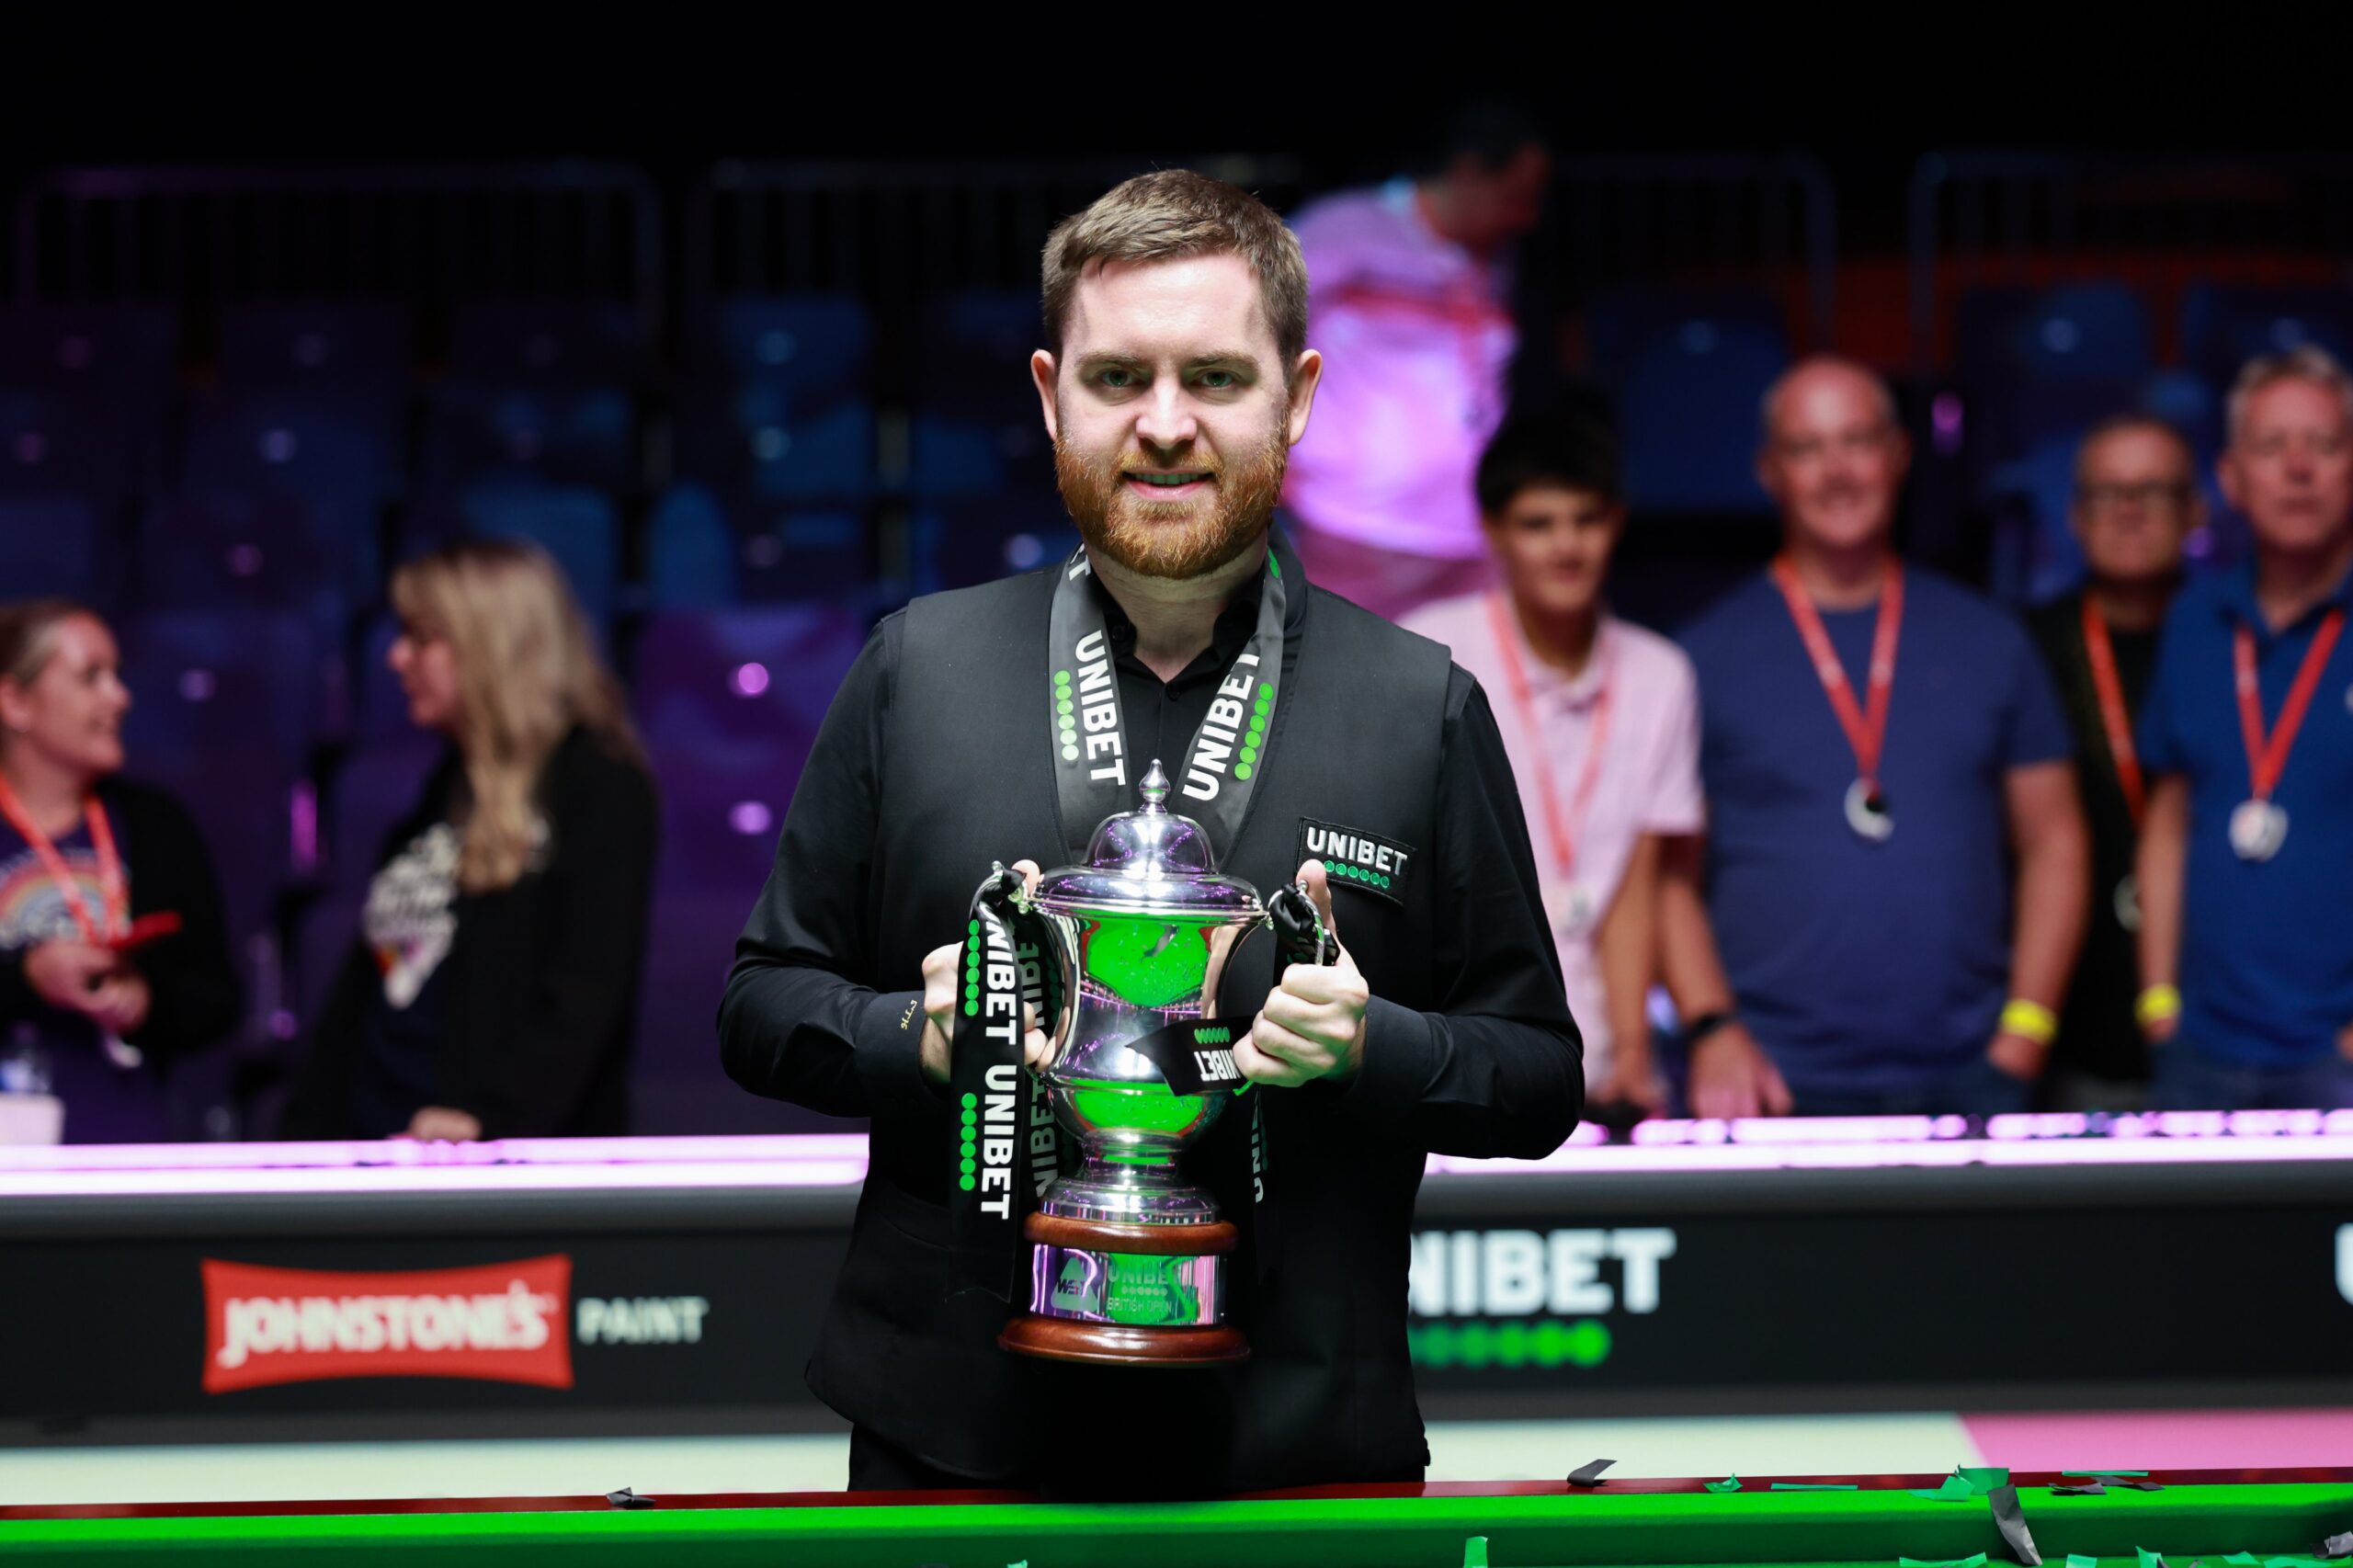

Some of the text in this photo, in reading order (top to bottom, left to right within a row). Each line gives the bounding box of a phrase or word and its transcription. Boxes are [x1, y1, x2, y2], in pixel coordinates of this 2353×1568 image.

[1075, 630, 1126, 785] UNIBET
[1306, 826, 1408, 876] UNIBET
[981, 1065, 1017, 1220] UNIBET
[1030, 1079, 1058, 1198] NIBET
[1108, 1264, 1179, 1285] UNIBE
[1408, 1227, 1677, 1316] NIBET
[576, 1297, 710, 1344] PAINT
